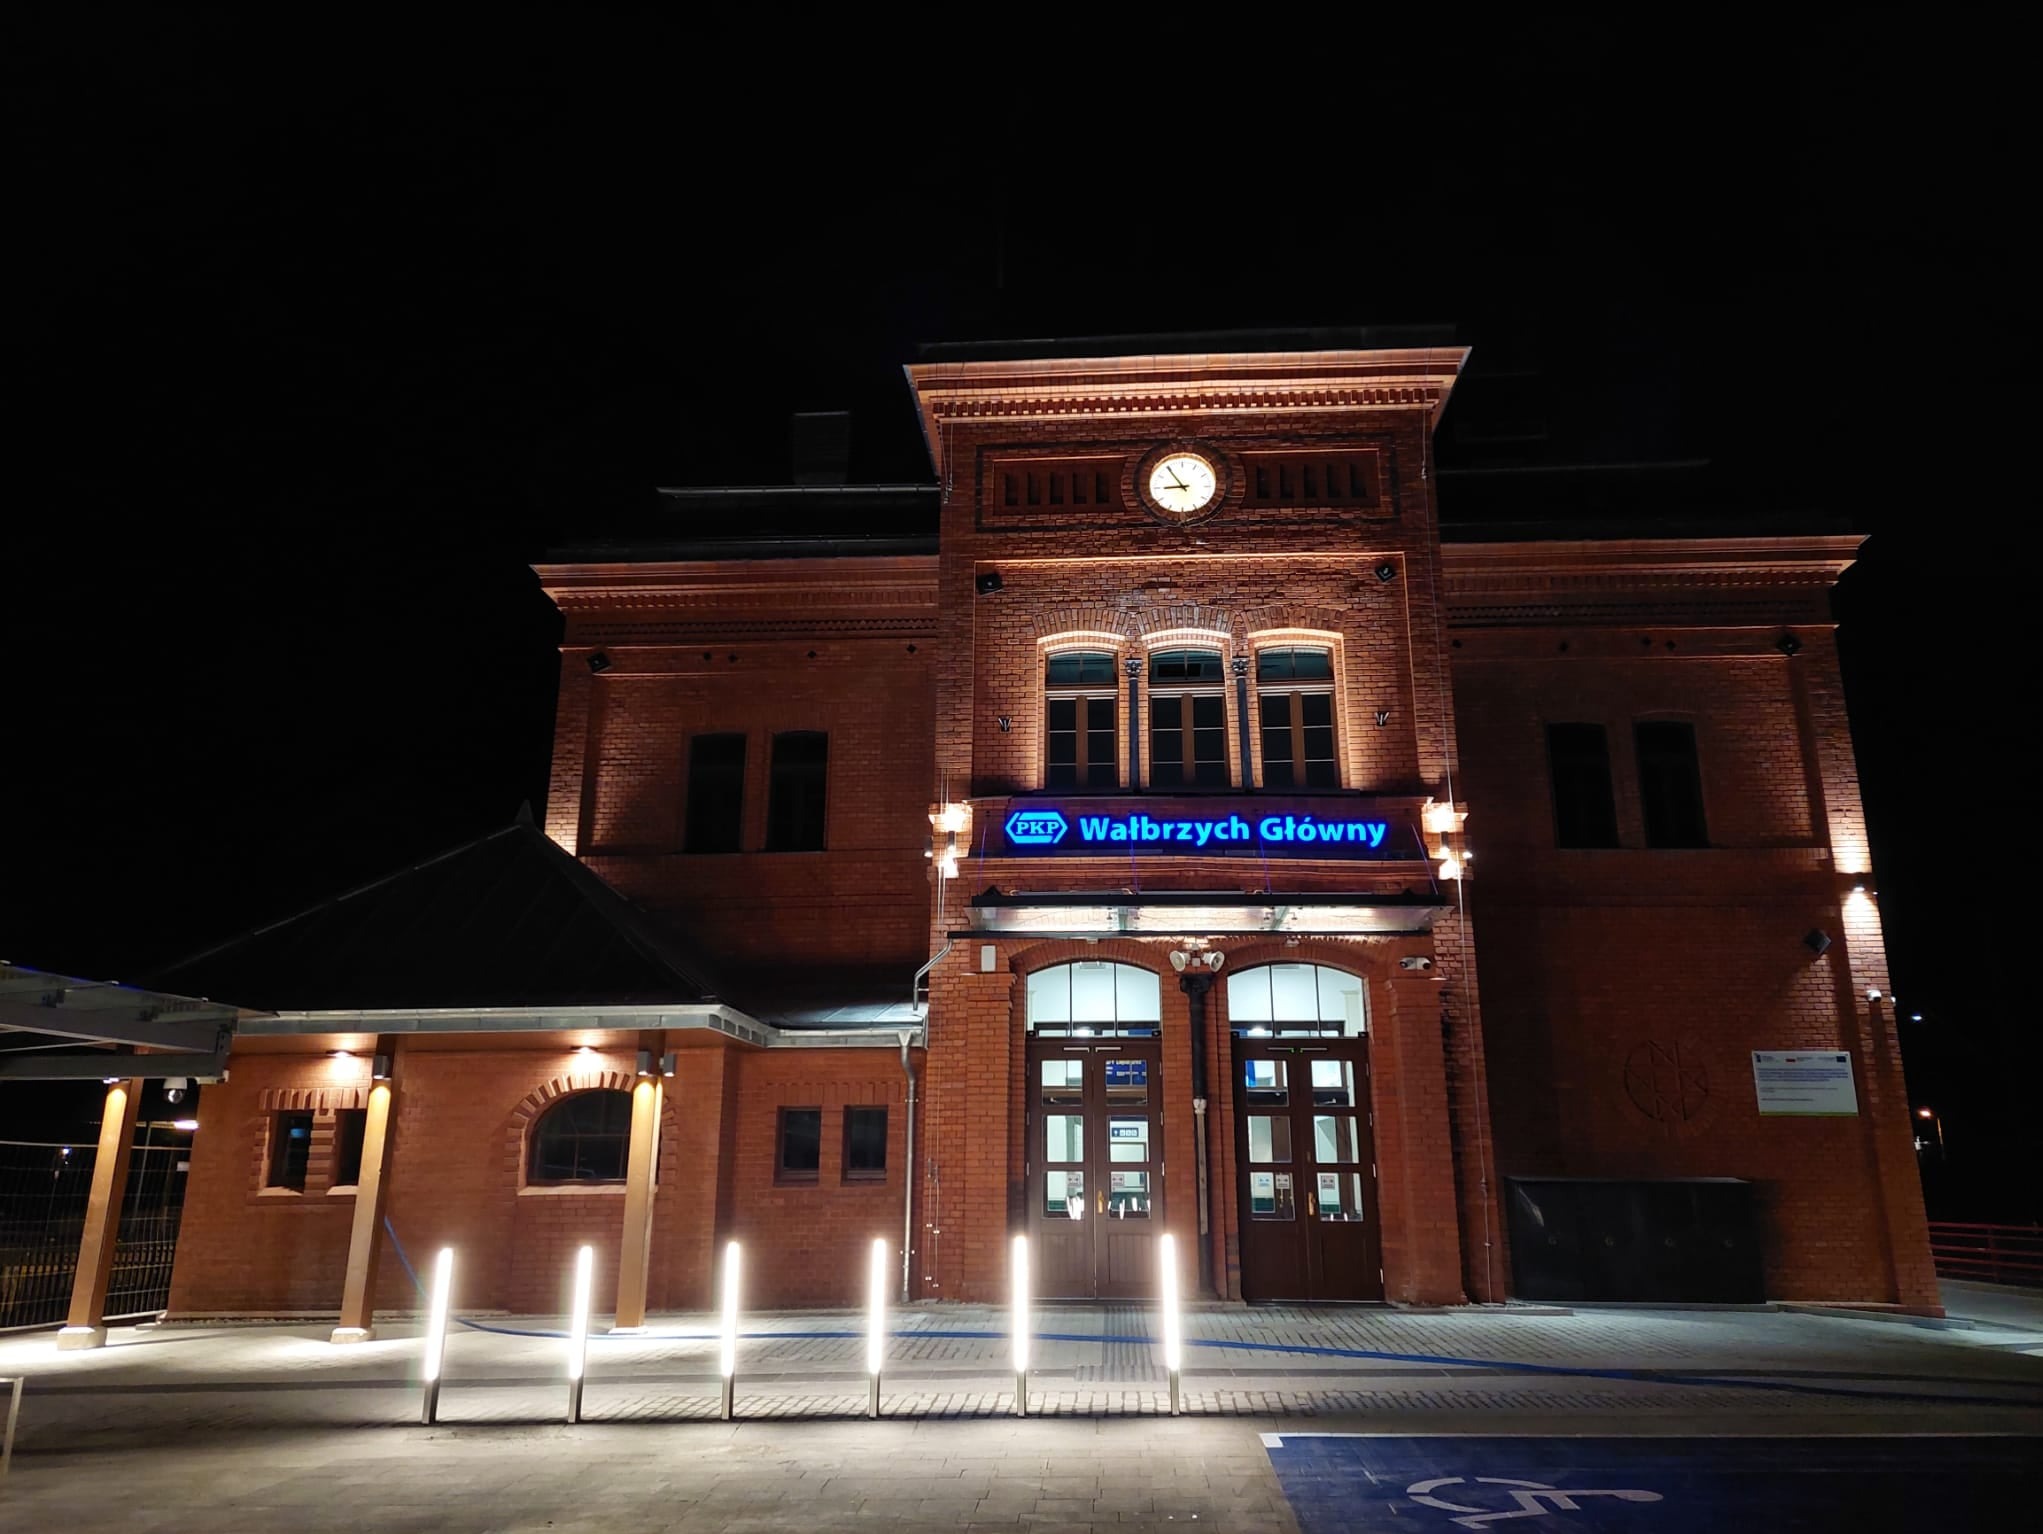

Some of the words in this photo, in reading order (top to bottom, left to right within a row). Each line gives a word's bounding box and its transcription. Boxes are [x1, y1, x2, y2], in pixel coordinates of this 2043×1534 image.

[1015, 821, 1060, 835] PKP
[1079, 815, 1250, 847] Wałbrzych
[1259, 815, 1386, 848] Główny
